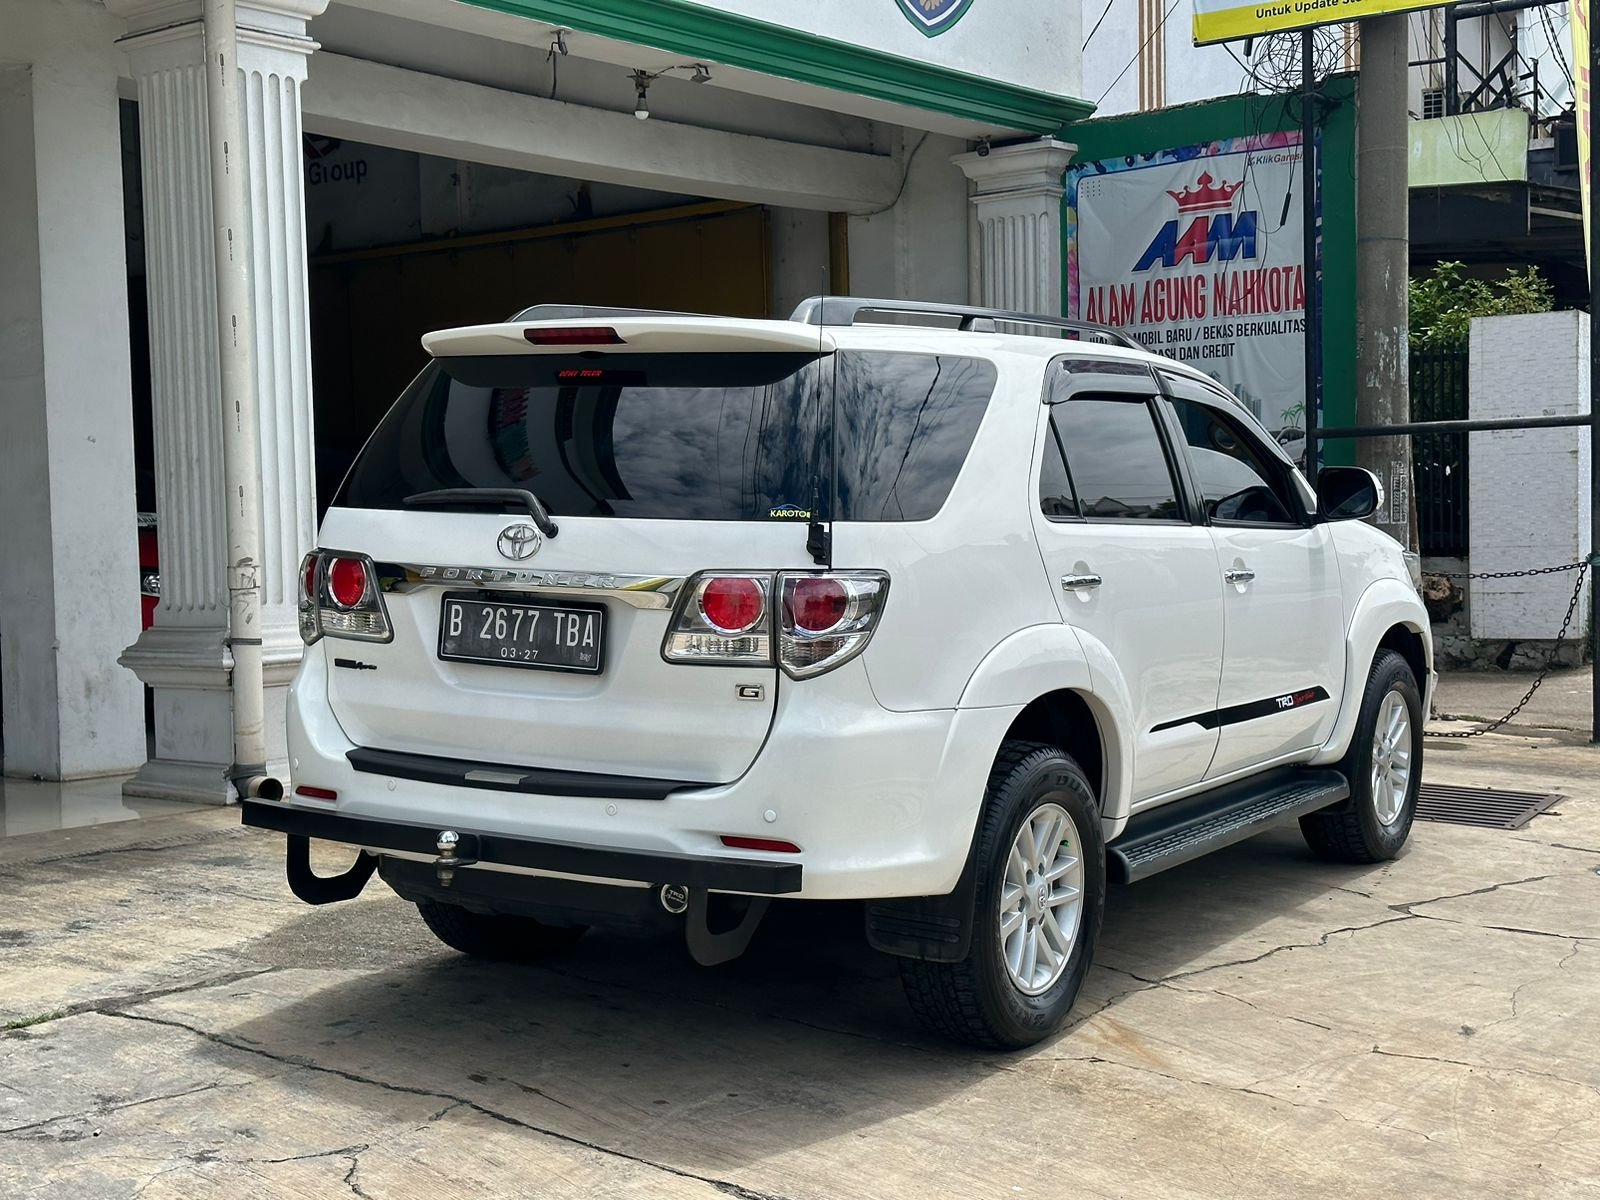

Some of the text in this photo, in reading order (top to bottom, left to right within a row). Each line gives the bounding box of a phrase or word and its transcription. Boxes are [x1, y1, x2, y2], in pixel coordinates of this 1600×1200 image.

[1256, 0, 1338, 18] Untuk Update
[1132, 211, 1257, 272] AAM
[1087, 265, 1305, 327] ALAM AGUNG MAHKOTA
[1166, 328, 1192, 343] BARU
[1203, 324, 1233, 339] BEKAS
[1236, 319, 1305, 337] BERKUALITAS
[1180, 346, 1199, 360] DAN
[1202, 343, 1235, 359] CREDIT
[420, 567, 617, 589] FORTUNER
[450, 604, 594, 647] B 2677 TBA
[738, 686, 760, 698] G
[1276, 695, 1294, 709] TRD
